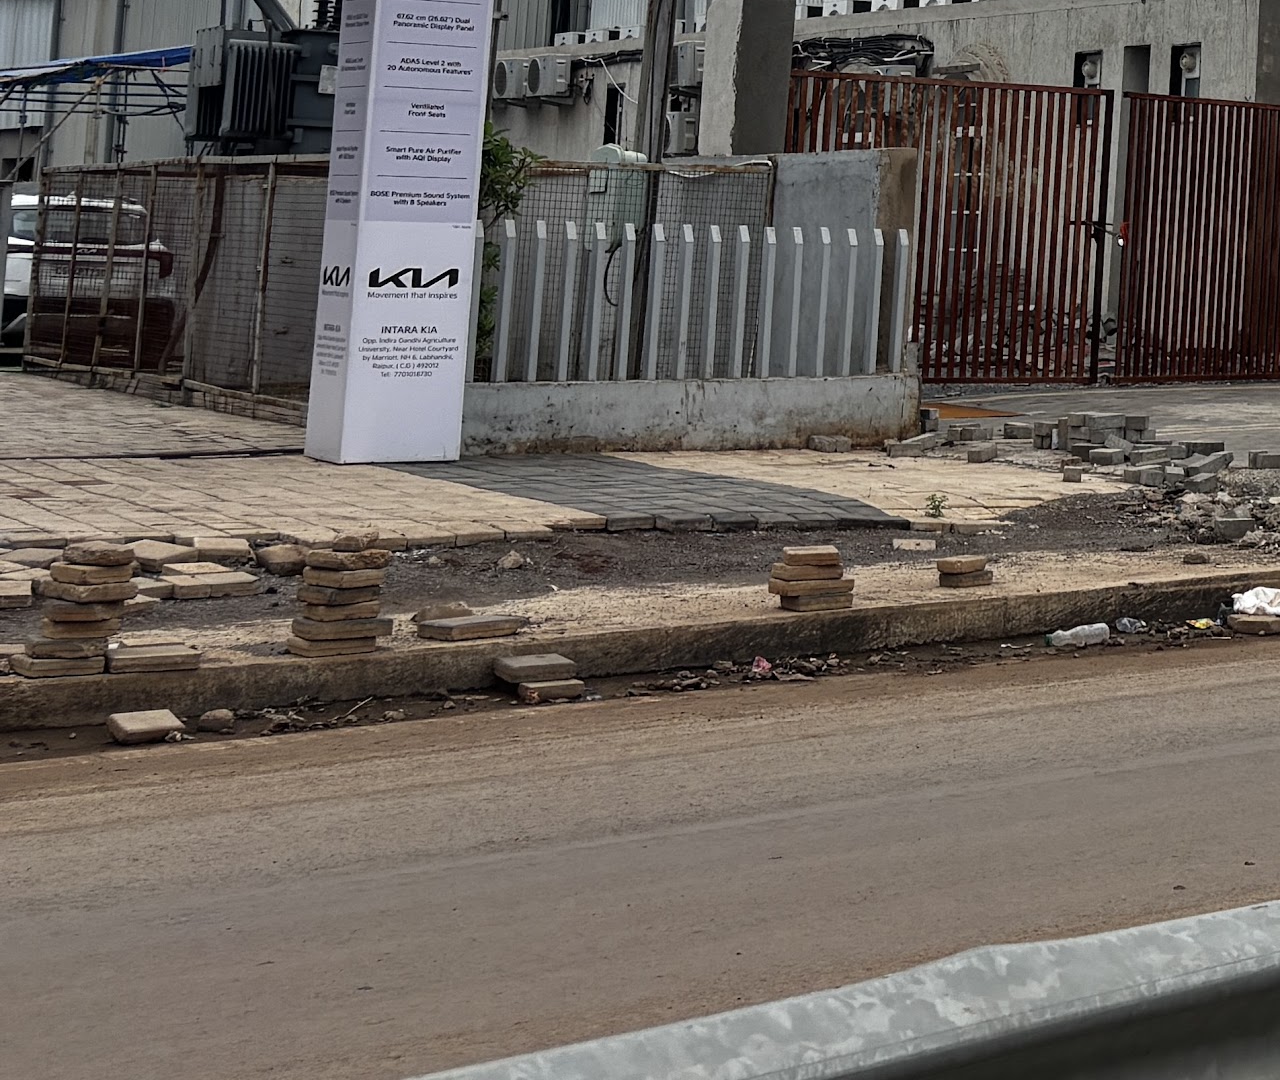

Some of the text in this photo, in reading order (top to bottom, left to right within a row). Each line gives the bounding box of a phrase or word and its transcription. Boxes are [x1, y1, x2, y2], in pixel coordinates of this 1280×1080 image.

[393, 20, 475, 32] Panoramic Display Panel
[400, 57, 420, 65] ADAS
[398, 65, 441, 74] Autonomous
[411, 102, 445, 110] Ventilated
[427, 155, 452, 163] Display
[446, 192, 471, 200] System
[368, 267, 459, 289] KIA
[367, 291, 409, 299] Movement
[428, 292, 458, 300] inspires
[381, 325, 438, 334] INTARA KIA
[422, 337, 456, 345] Agriculture
